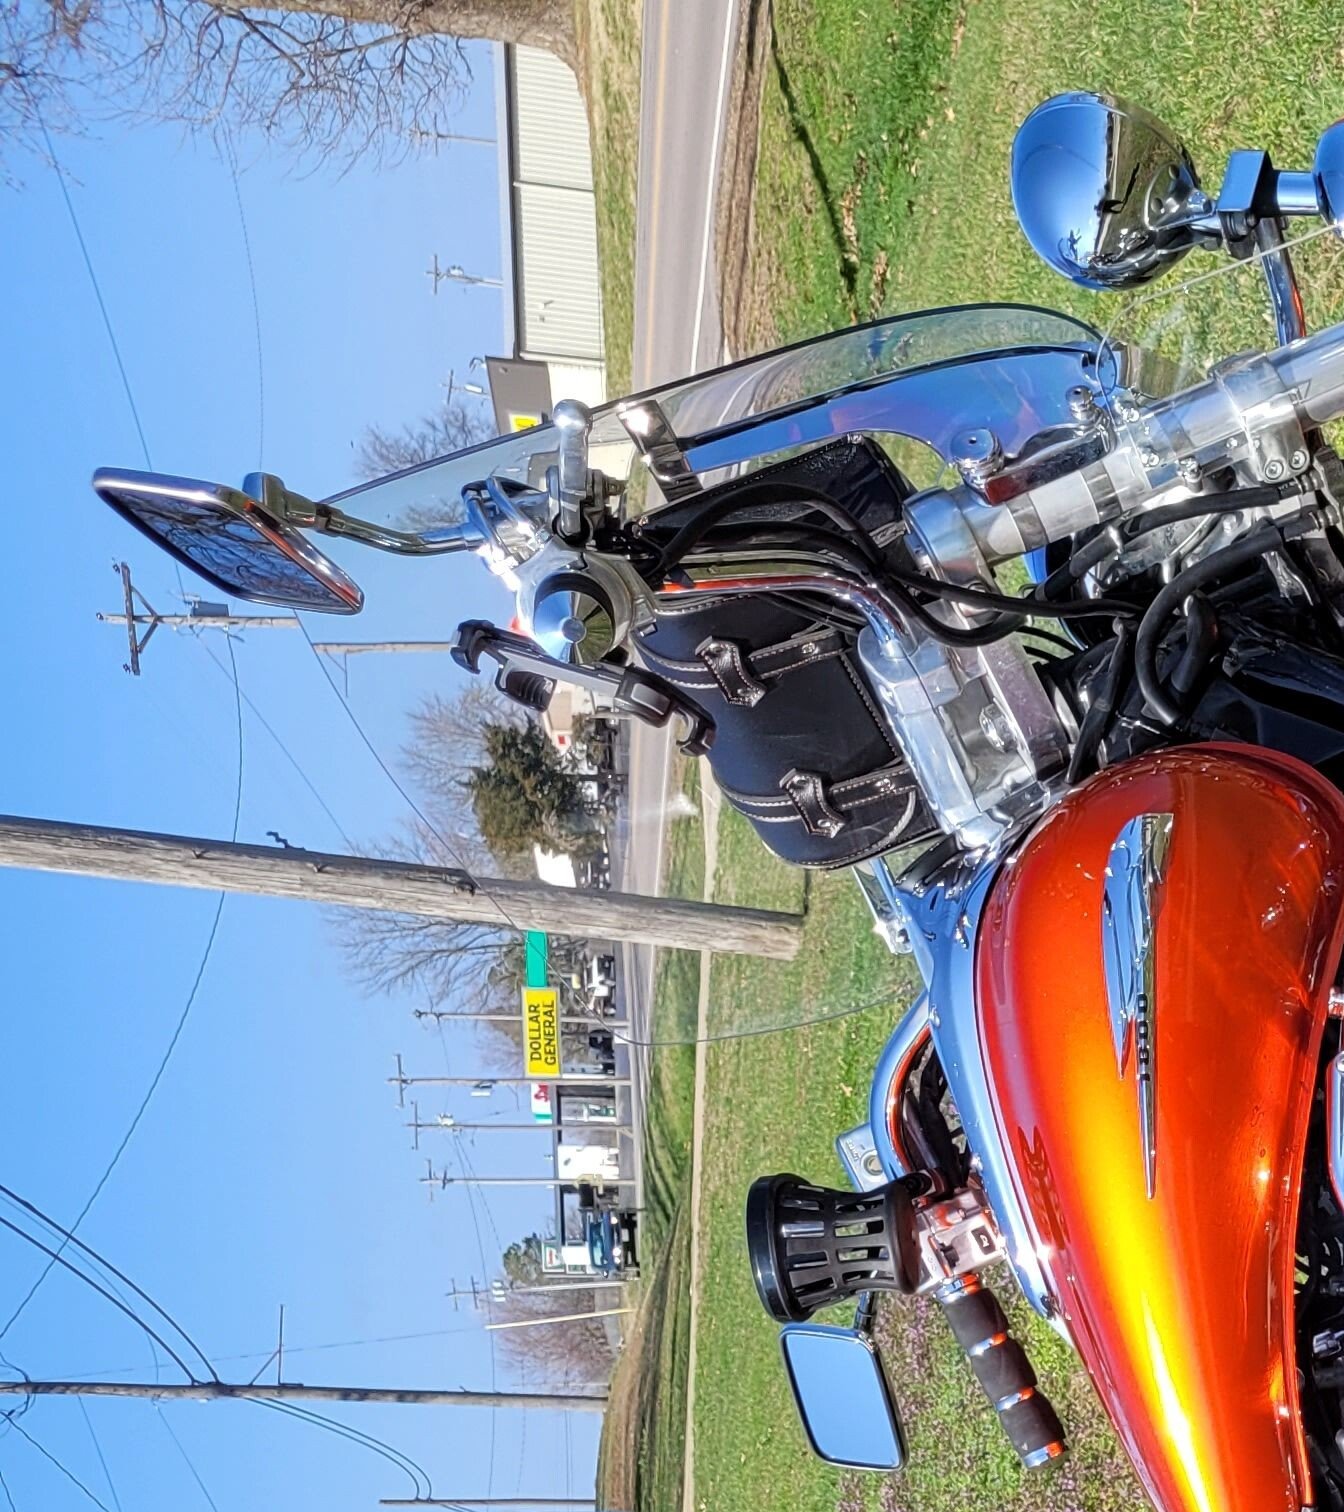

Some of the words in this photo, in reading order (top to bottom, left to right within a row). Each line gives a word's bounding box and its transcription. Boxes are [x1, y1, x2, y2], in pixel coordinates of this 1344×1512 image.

[528, 1003, 541, 1062] DOLLAR
[543, 1000, 556, 1065] GENERAL
[1137, 993, 1150, 1082] 1800
